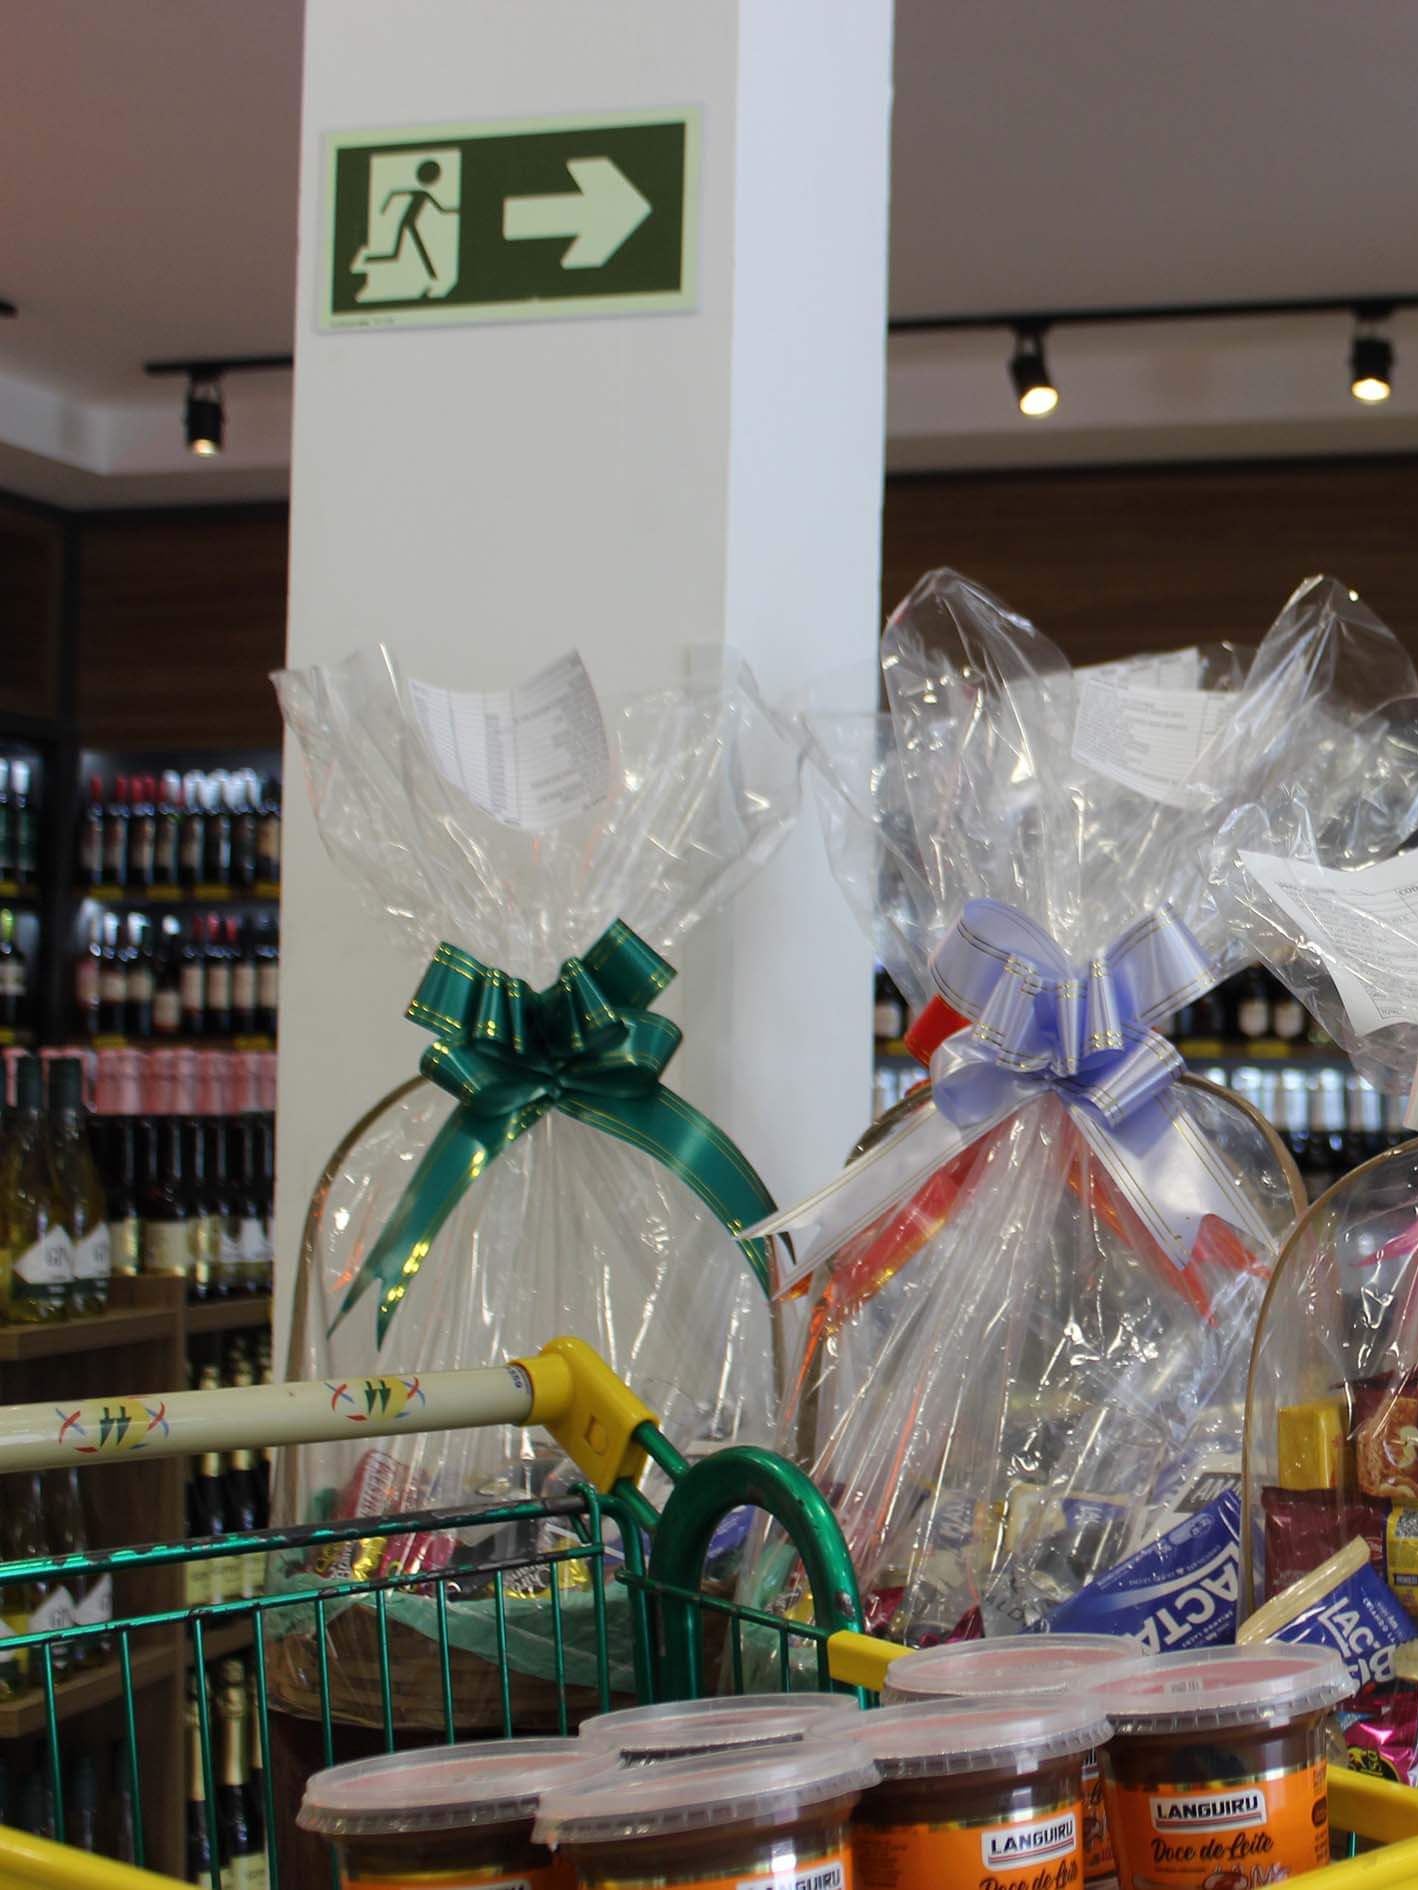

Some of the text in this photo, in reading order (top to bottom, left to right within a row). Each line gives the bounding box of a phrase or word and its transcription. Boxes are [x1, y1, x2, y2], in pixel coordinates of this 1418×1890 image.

[1317, 1597, 1381, 1659] LAC
[1156, 1795, 1260, 1821] LANGUIRU
[990, 1819, 1074, 1855] LANGUIRU
[1151, 1831, 1274, 1863] Doce de Leite
